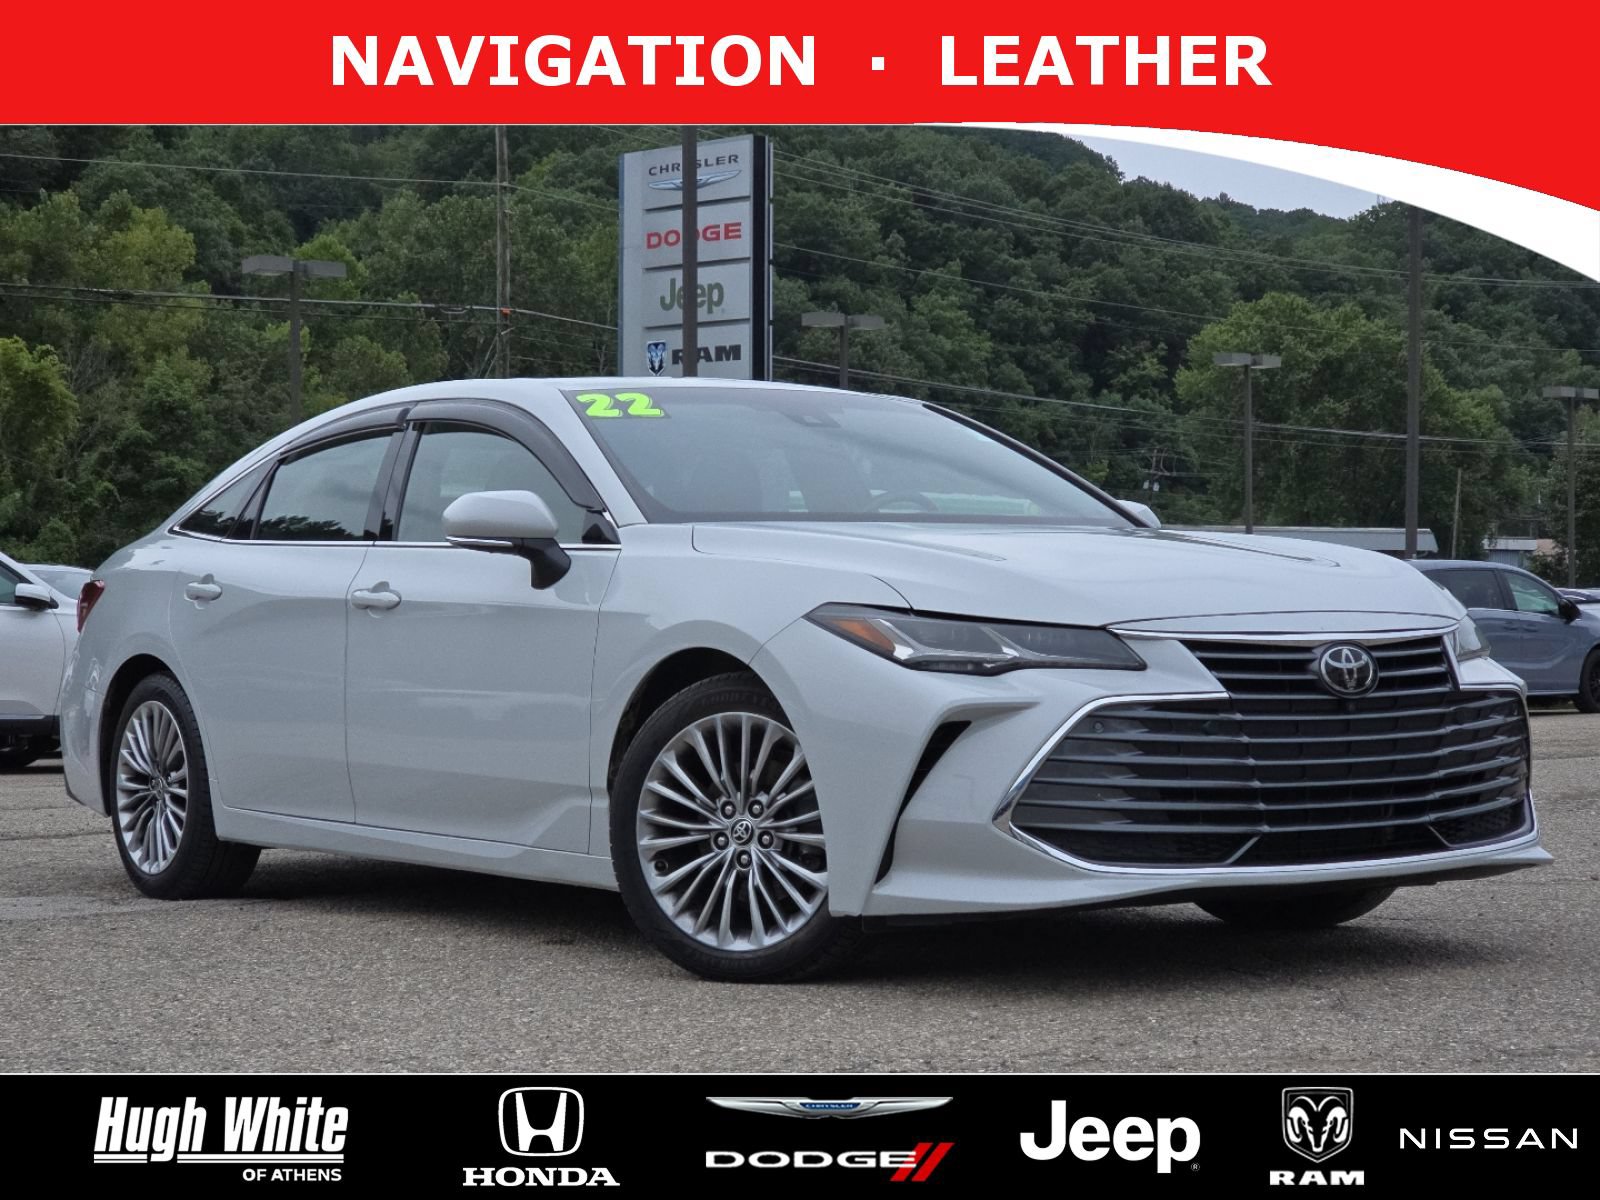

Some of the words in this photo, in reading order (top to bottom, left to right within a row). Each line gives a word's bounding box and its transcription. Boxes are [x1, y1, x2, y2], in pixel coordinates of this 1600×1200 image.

[648, 153, 739, 177] CHRSLER
[646, 221, 742, 250] DOGE
[576, 392, 664, 418] 22
